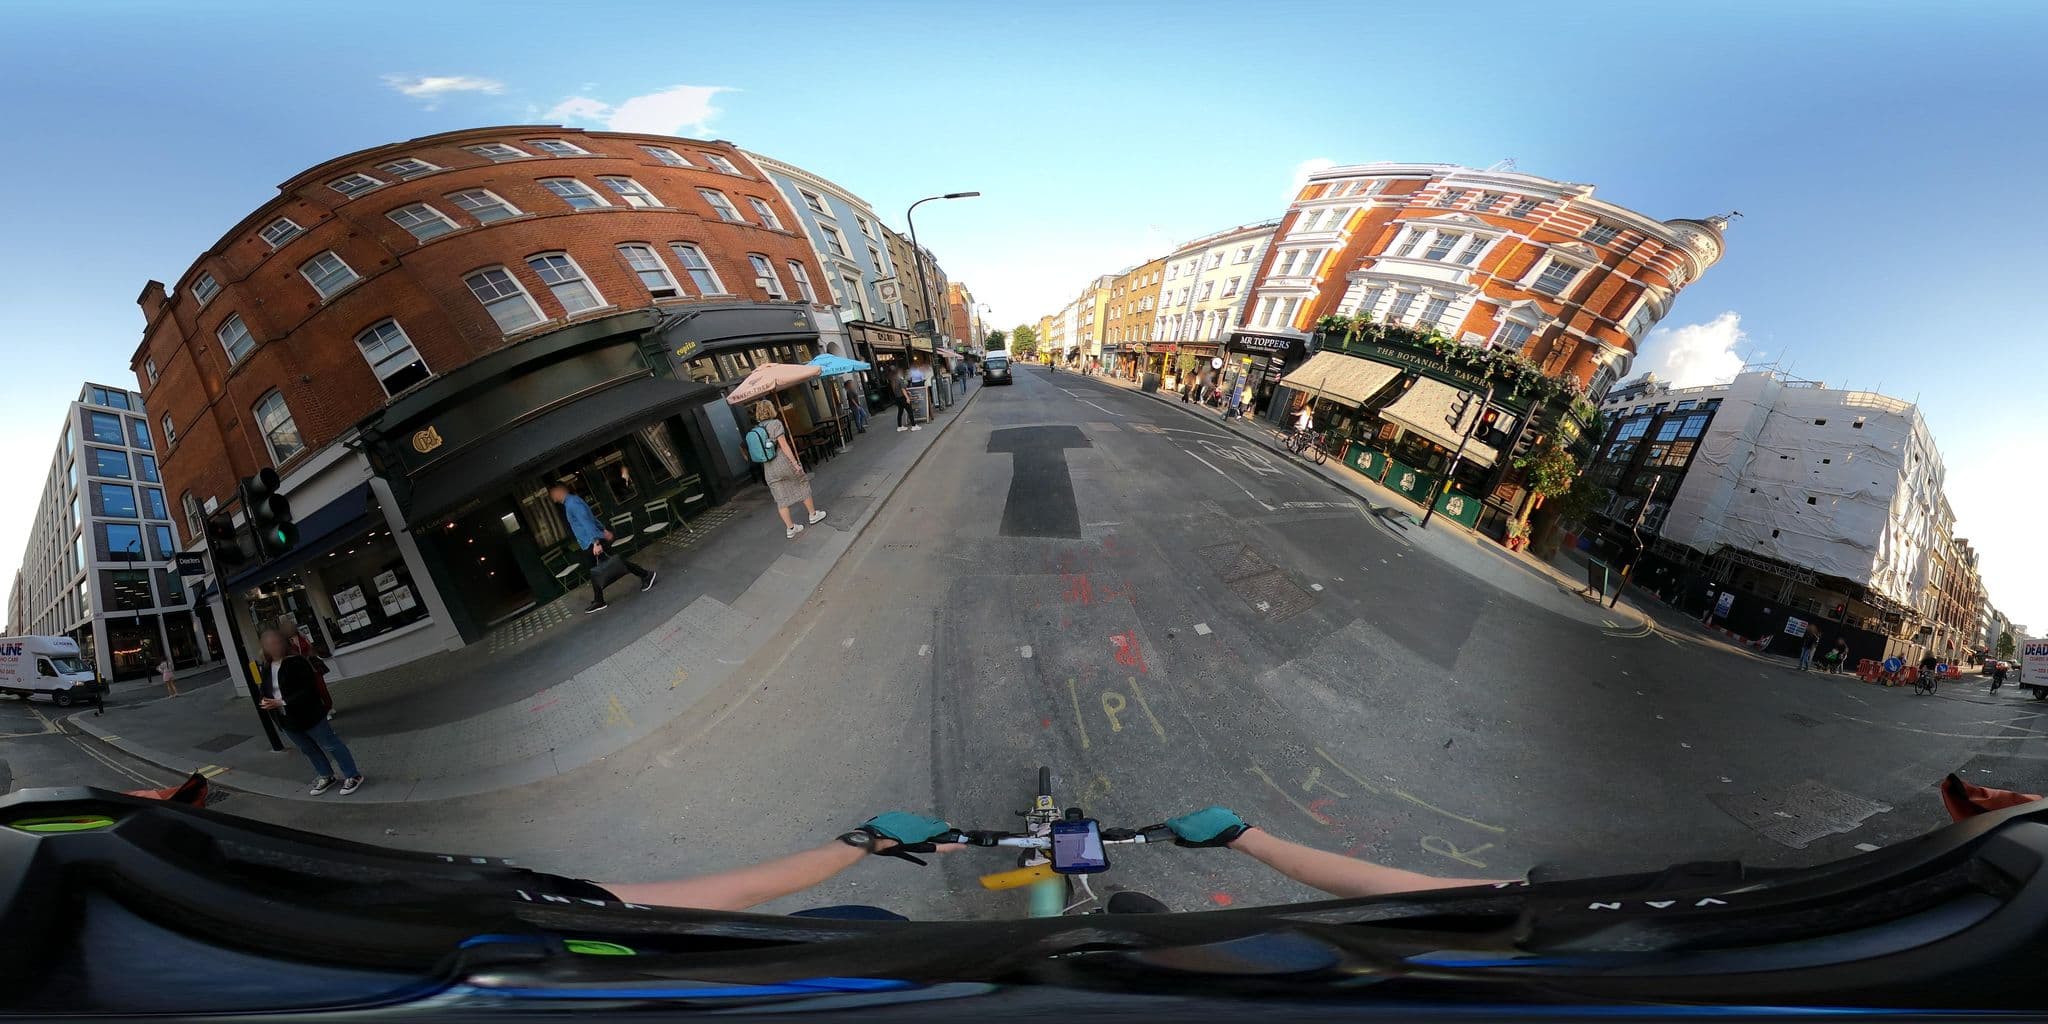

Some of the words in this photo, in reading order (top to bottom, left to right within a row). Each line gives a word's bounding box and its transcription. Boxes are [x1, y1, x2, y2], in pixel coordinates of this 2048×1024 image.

[676, 339, 697, 356] copita
[1240, 336, 1253, 345] MR
[1254, 337, 1291, 349] TOPPERS
[1376, 346, 1395, 357] THE
[1396, 350, 1451, 374] BOTANICAL
[1454, 369, 1494, 390] TAVERN
[0, 642, 24, 656] LINE
